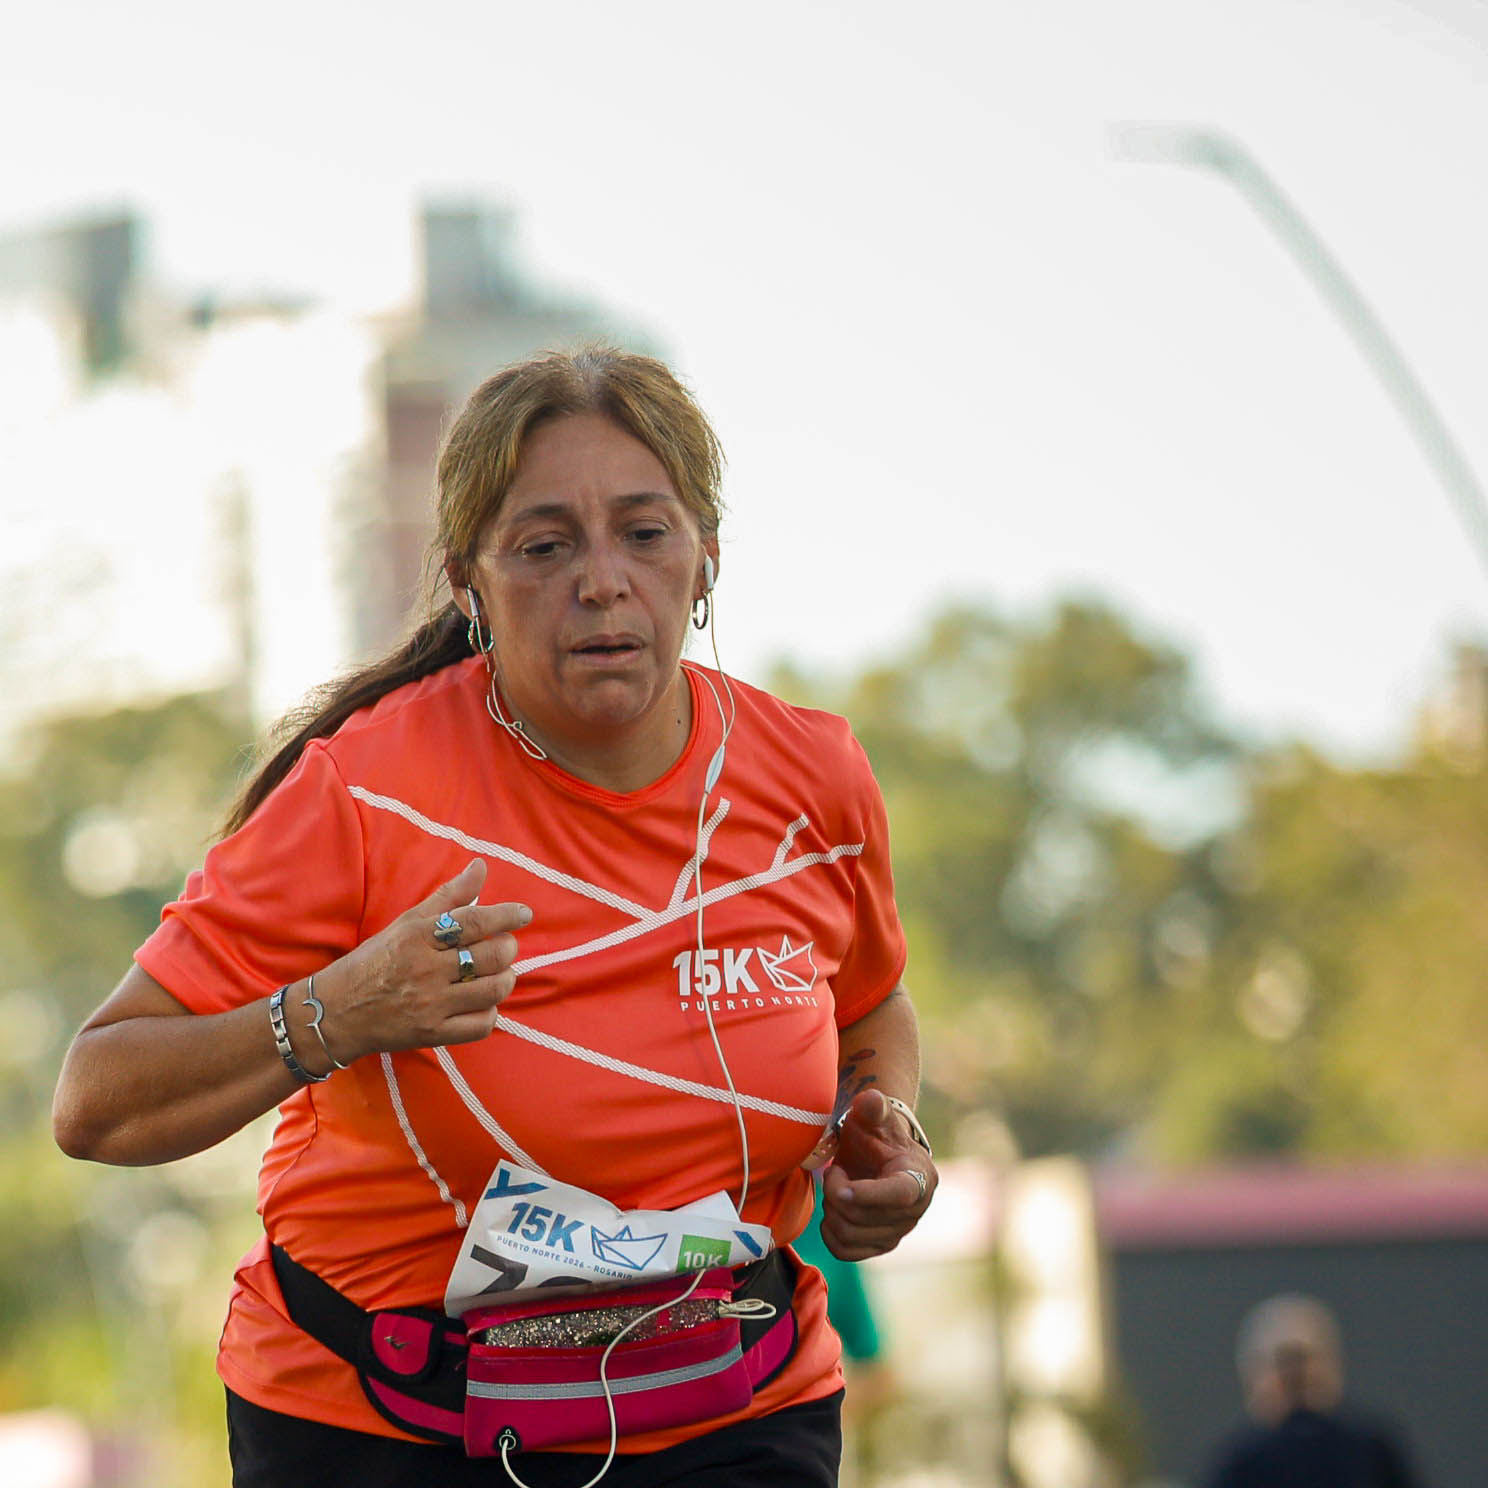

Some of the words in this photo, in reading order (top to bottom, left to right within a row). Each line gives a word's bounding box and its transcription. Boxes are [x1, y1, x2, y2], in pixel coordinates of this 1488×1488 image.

[672, 948, 761, 996] 15K
[680, 997, 765, 1012] PUERTO
[506, 1202, 585, 1254] 15K
[496, 1235, 531, 1253] PUERTO
[531, 1248, 561, 1261] NORTE
[563, 1256, 585, 1269] 2026
[683, 1251, 723, 1269] 10K
